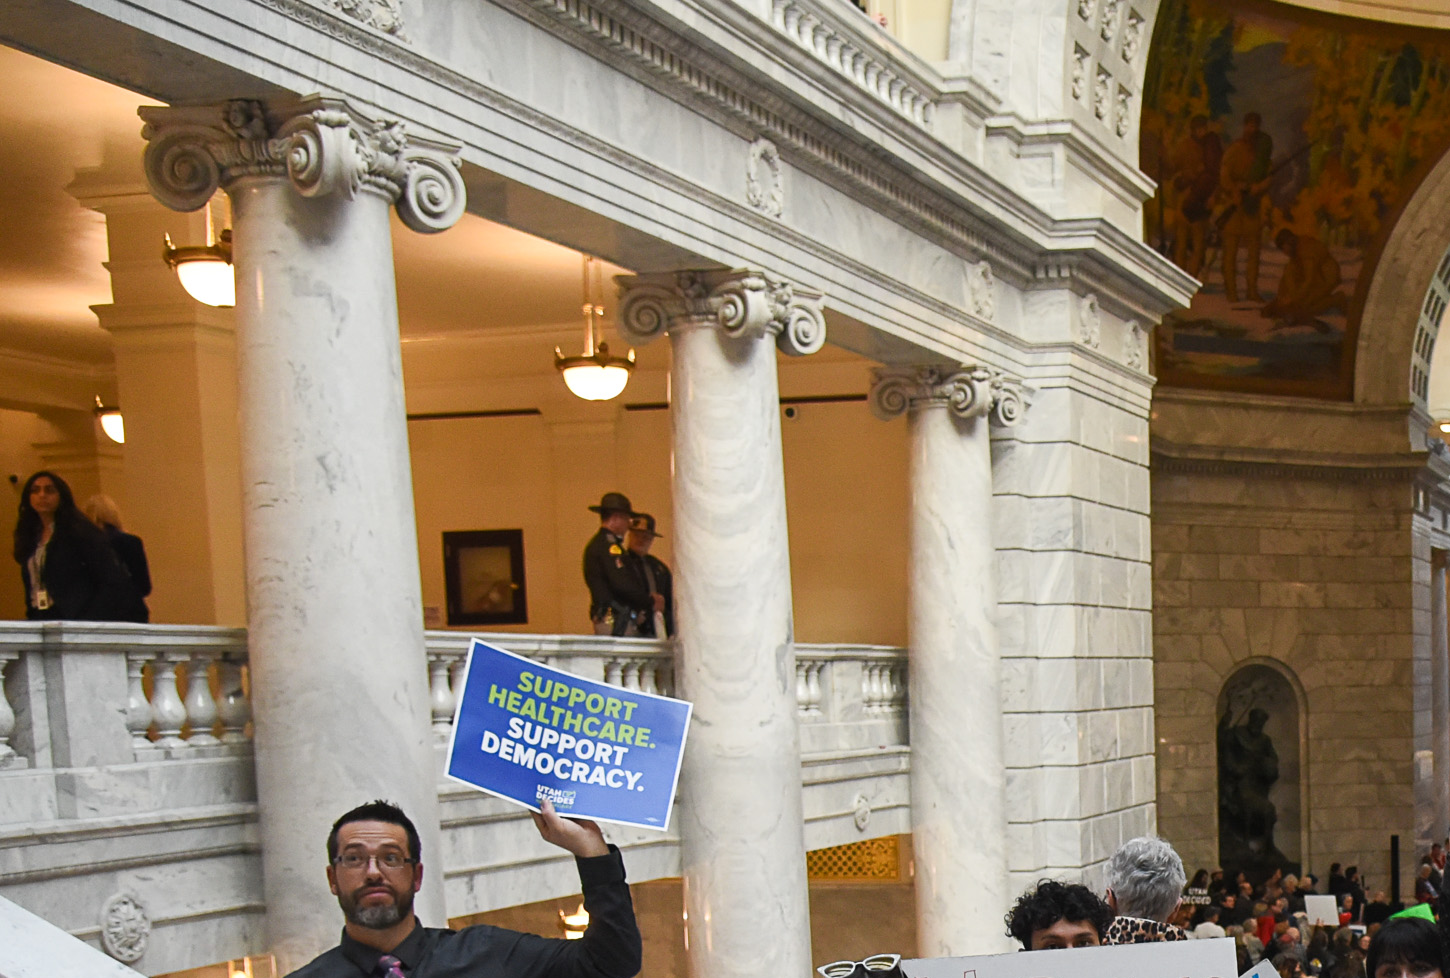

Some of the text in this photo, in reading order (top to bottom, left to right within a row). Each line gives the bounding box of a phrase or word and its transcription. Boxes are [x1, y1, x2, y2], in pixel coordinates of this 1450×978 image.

[488, 684, 656, 749] HEALTHCARE.
[518, 671, 638, 721] SUPPORT
[481, 730, 645, 792] DEMOCRACY.
[507, 717, 629, 766] SUPPORT
[535, 791, 575, 805] DECIDES
[537, 784, 562, 796] UTAH
